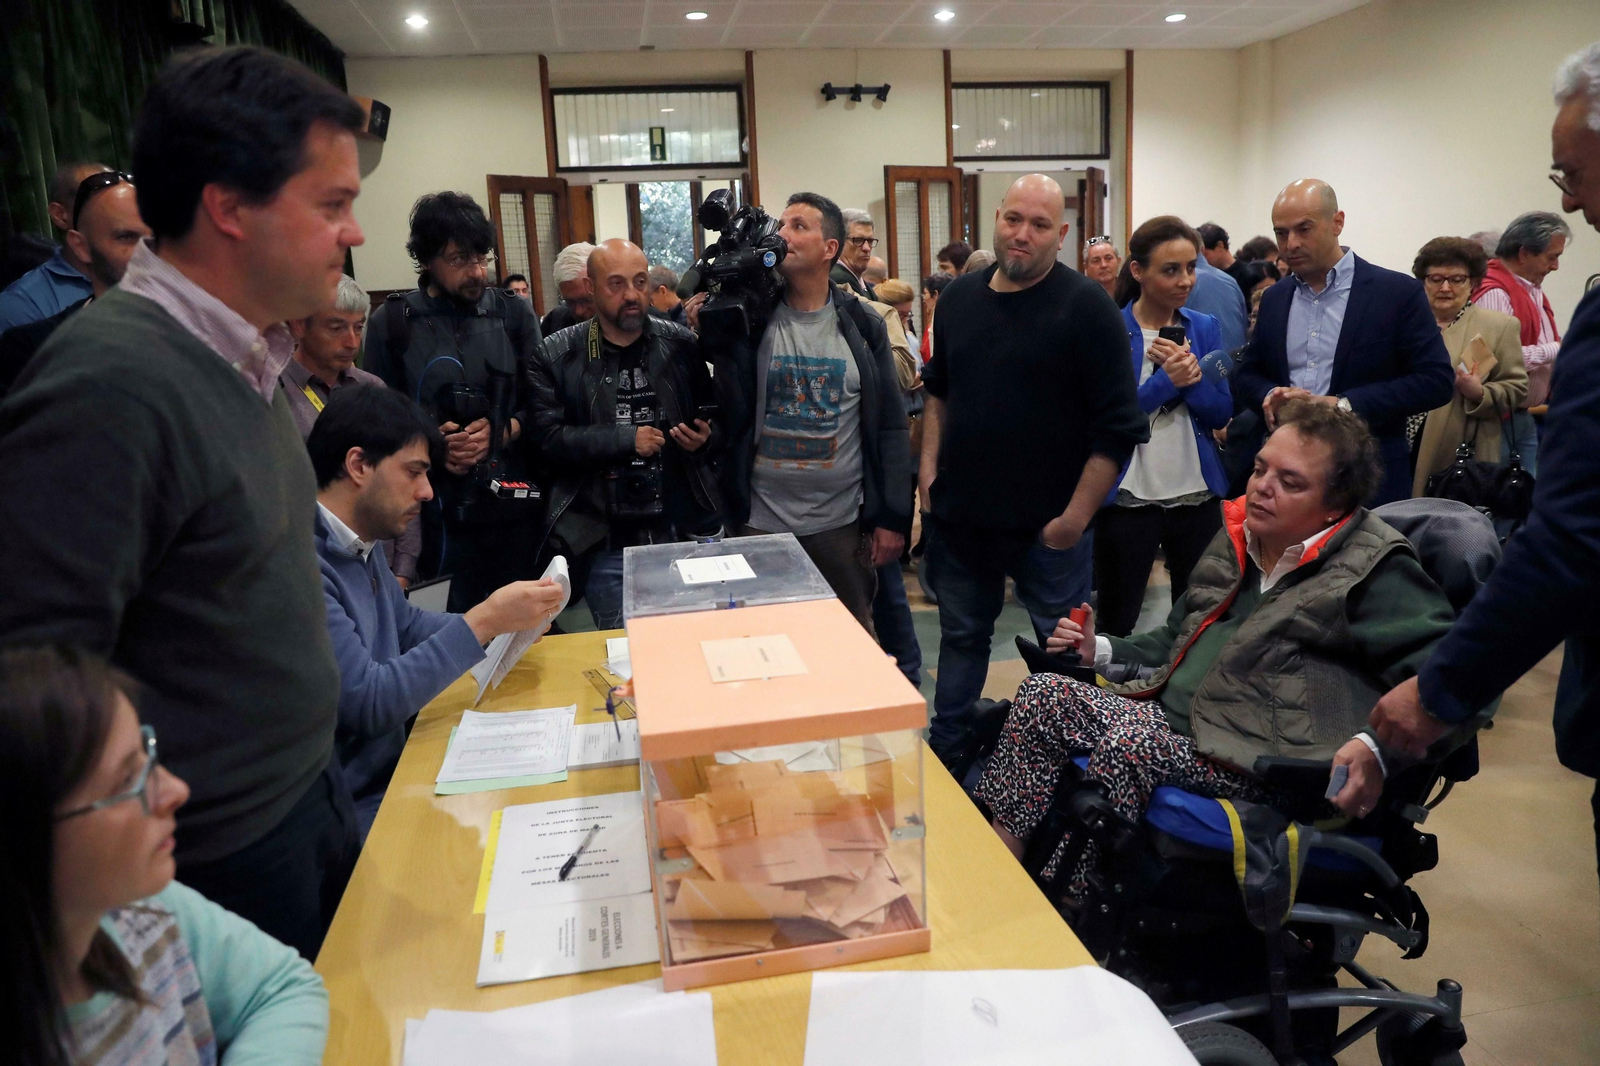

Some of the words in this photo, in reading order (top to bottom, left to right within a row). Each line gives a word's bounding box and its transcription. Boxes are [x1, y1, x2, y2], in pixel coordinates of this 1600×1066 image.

[1215, 359, 1228, 378] tve
[546, 805, 599, 815] INSTRUCCIONES
[575, 814, 613, 822] ELECTORAL
[600, 905, 609, 929] CORTES
[613, 911, 623, 945] ELECCIONES
[601, 928, 611, 959] GENERALES
